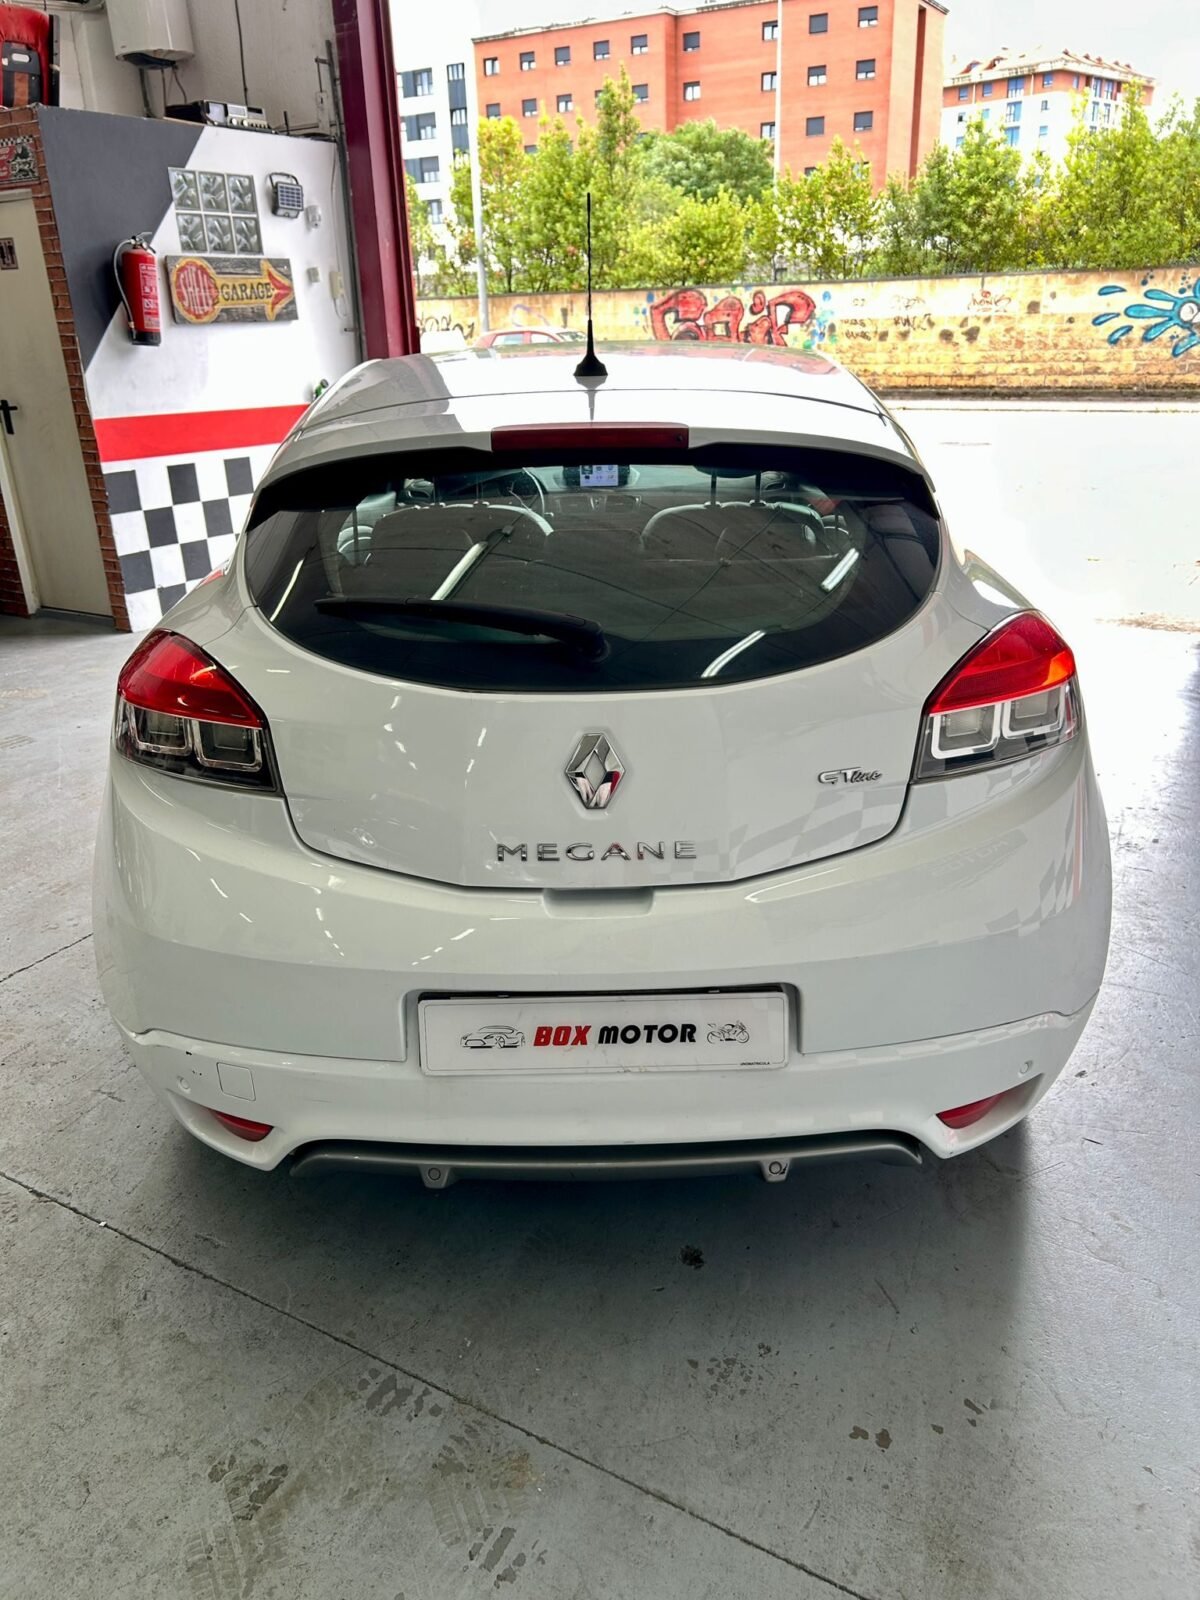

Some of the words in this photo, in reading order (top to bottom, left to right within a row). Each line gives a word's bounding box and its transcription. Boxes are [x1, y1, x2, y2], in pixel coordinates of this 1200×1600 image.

[220, 282, 273, 301] GARAGE
[496, 841, 697, 862] MEGANE
[533, 1025, 592, 1047] BOX
[598, 1023, 697, 1044] MOTOR
